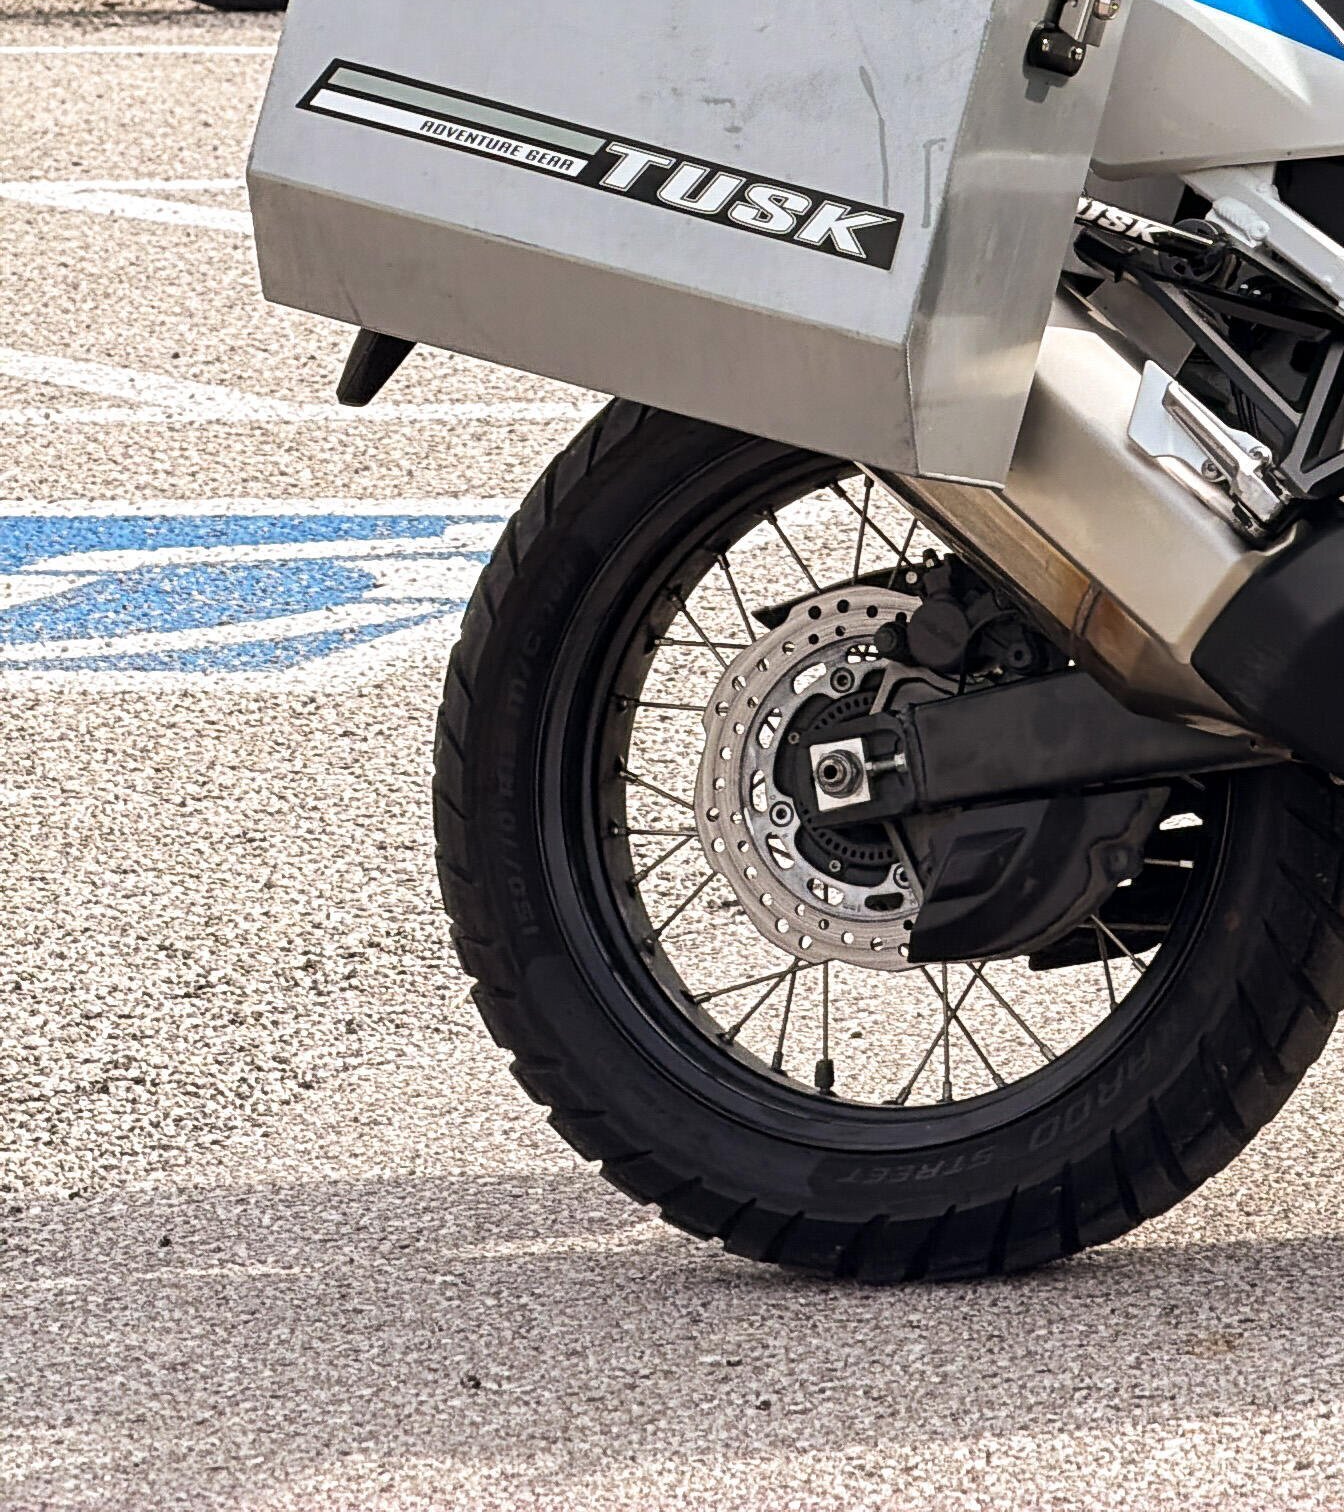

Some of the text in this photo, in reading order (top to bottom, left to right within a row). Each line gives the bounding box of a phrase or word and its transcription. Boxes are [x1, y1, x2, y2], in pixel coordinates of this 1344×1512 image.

[420, 119, 575, 174] ADVENTURE GEAR
[599, 141, 899, 259] TUSK
